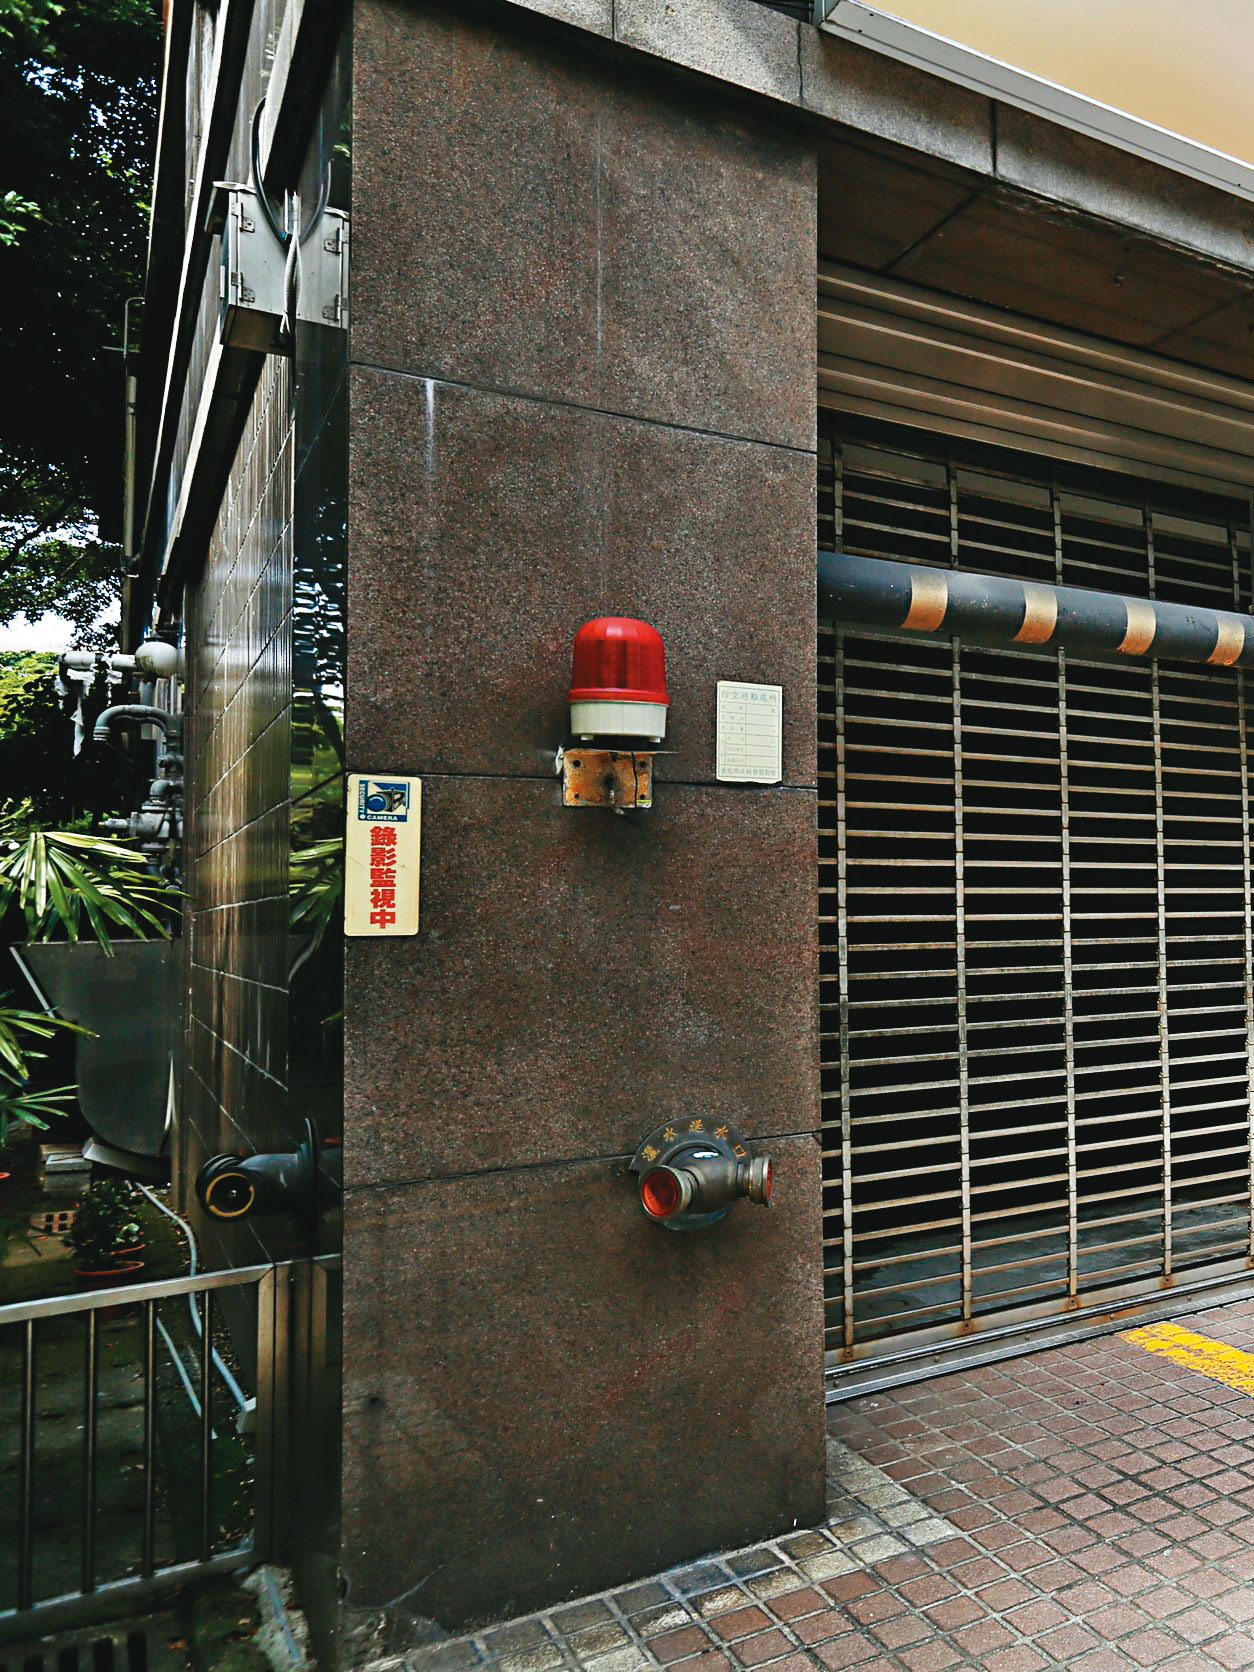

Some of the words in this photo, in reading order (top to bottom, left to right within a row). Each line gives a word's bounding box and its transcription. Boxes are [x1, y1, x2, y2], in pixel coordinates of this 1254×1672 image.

[358, 783, 366, 814] SECURITY
[369, 825, 398, 930] 錄影監視中
